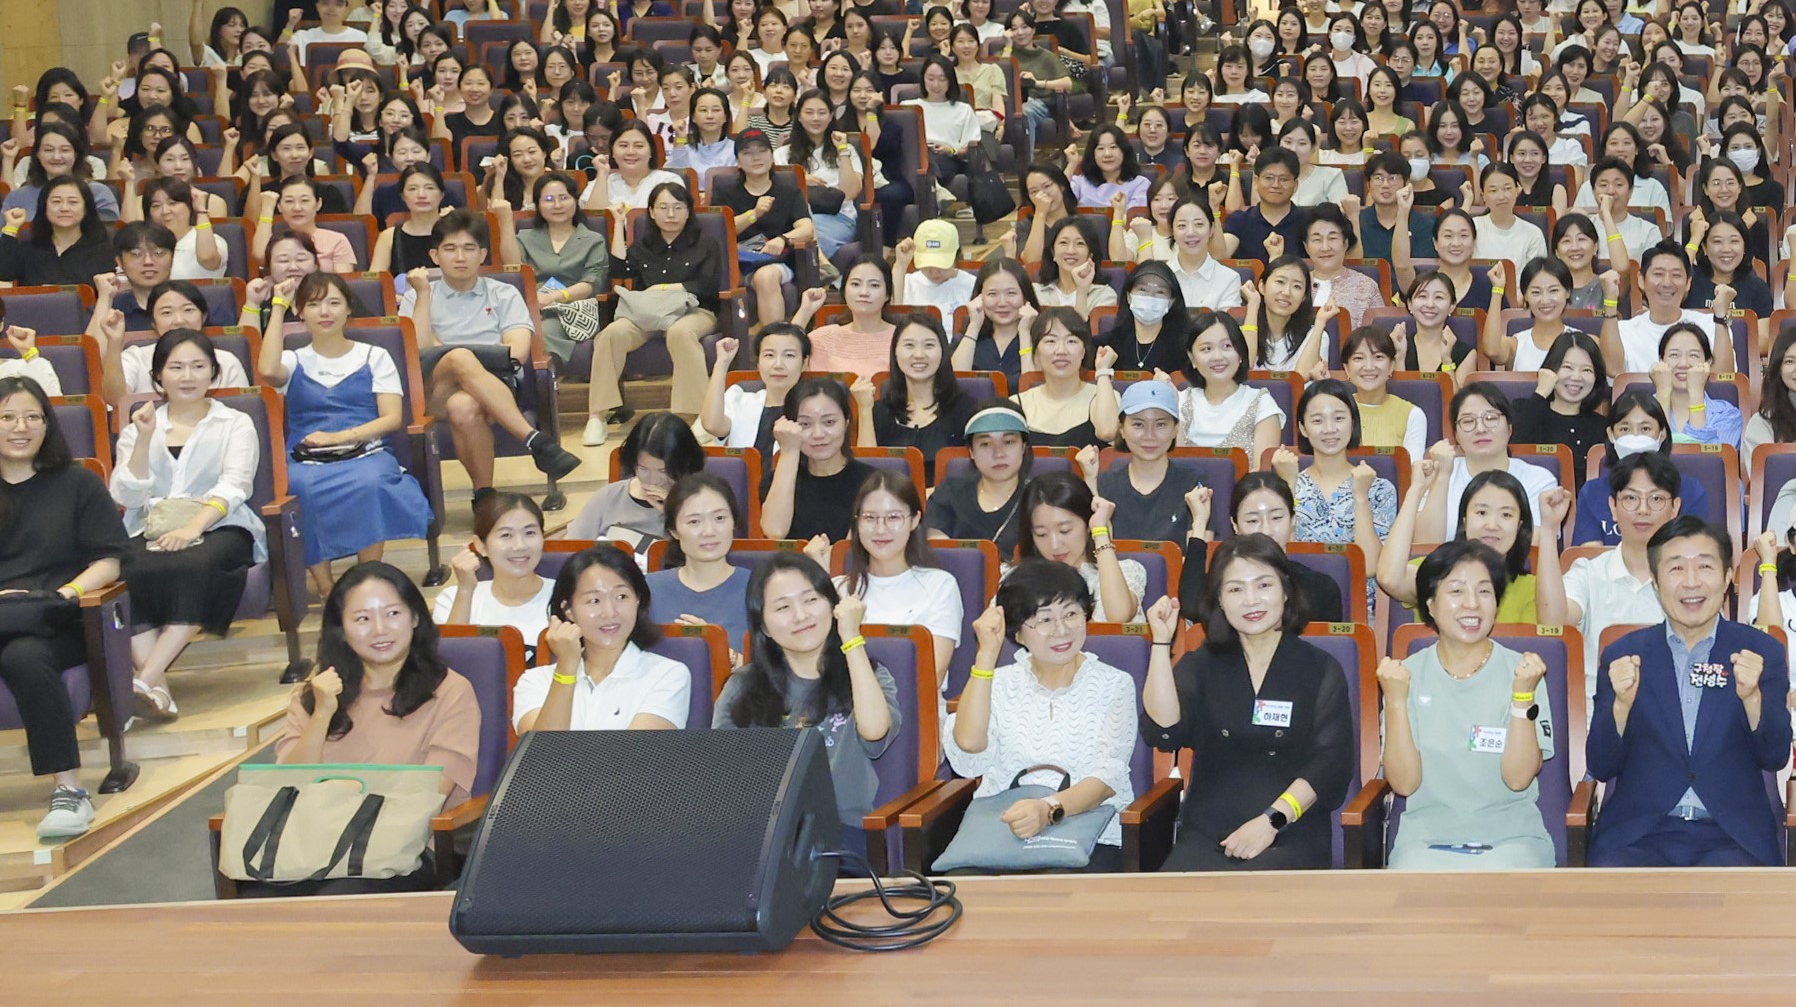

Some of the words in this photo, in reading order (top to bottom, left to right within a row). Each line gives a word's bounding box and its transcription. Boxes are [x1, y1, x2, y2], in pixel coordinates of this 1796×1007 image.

[1125, 625, 1143, 633] 3-21
[1333, 625, 1351, 633] 3-20
[1541, 626, 1558, 634] 3-19
